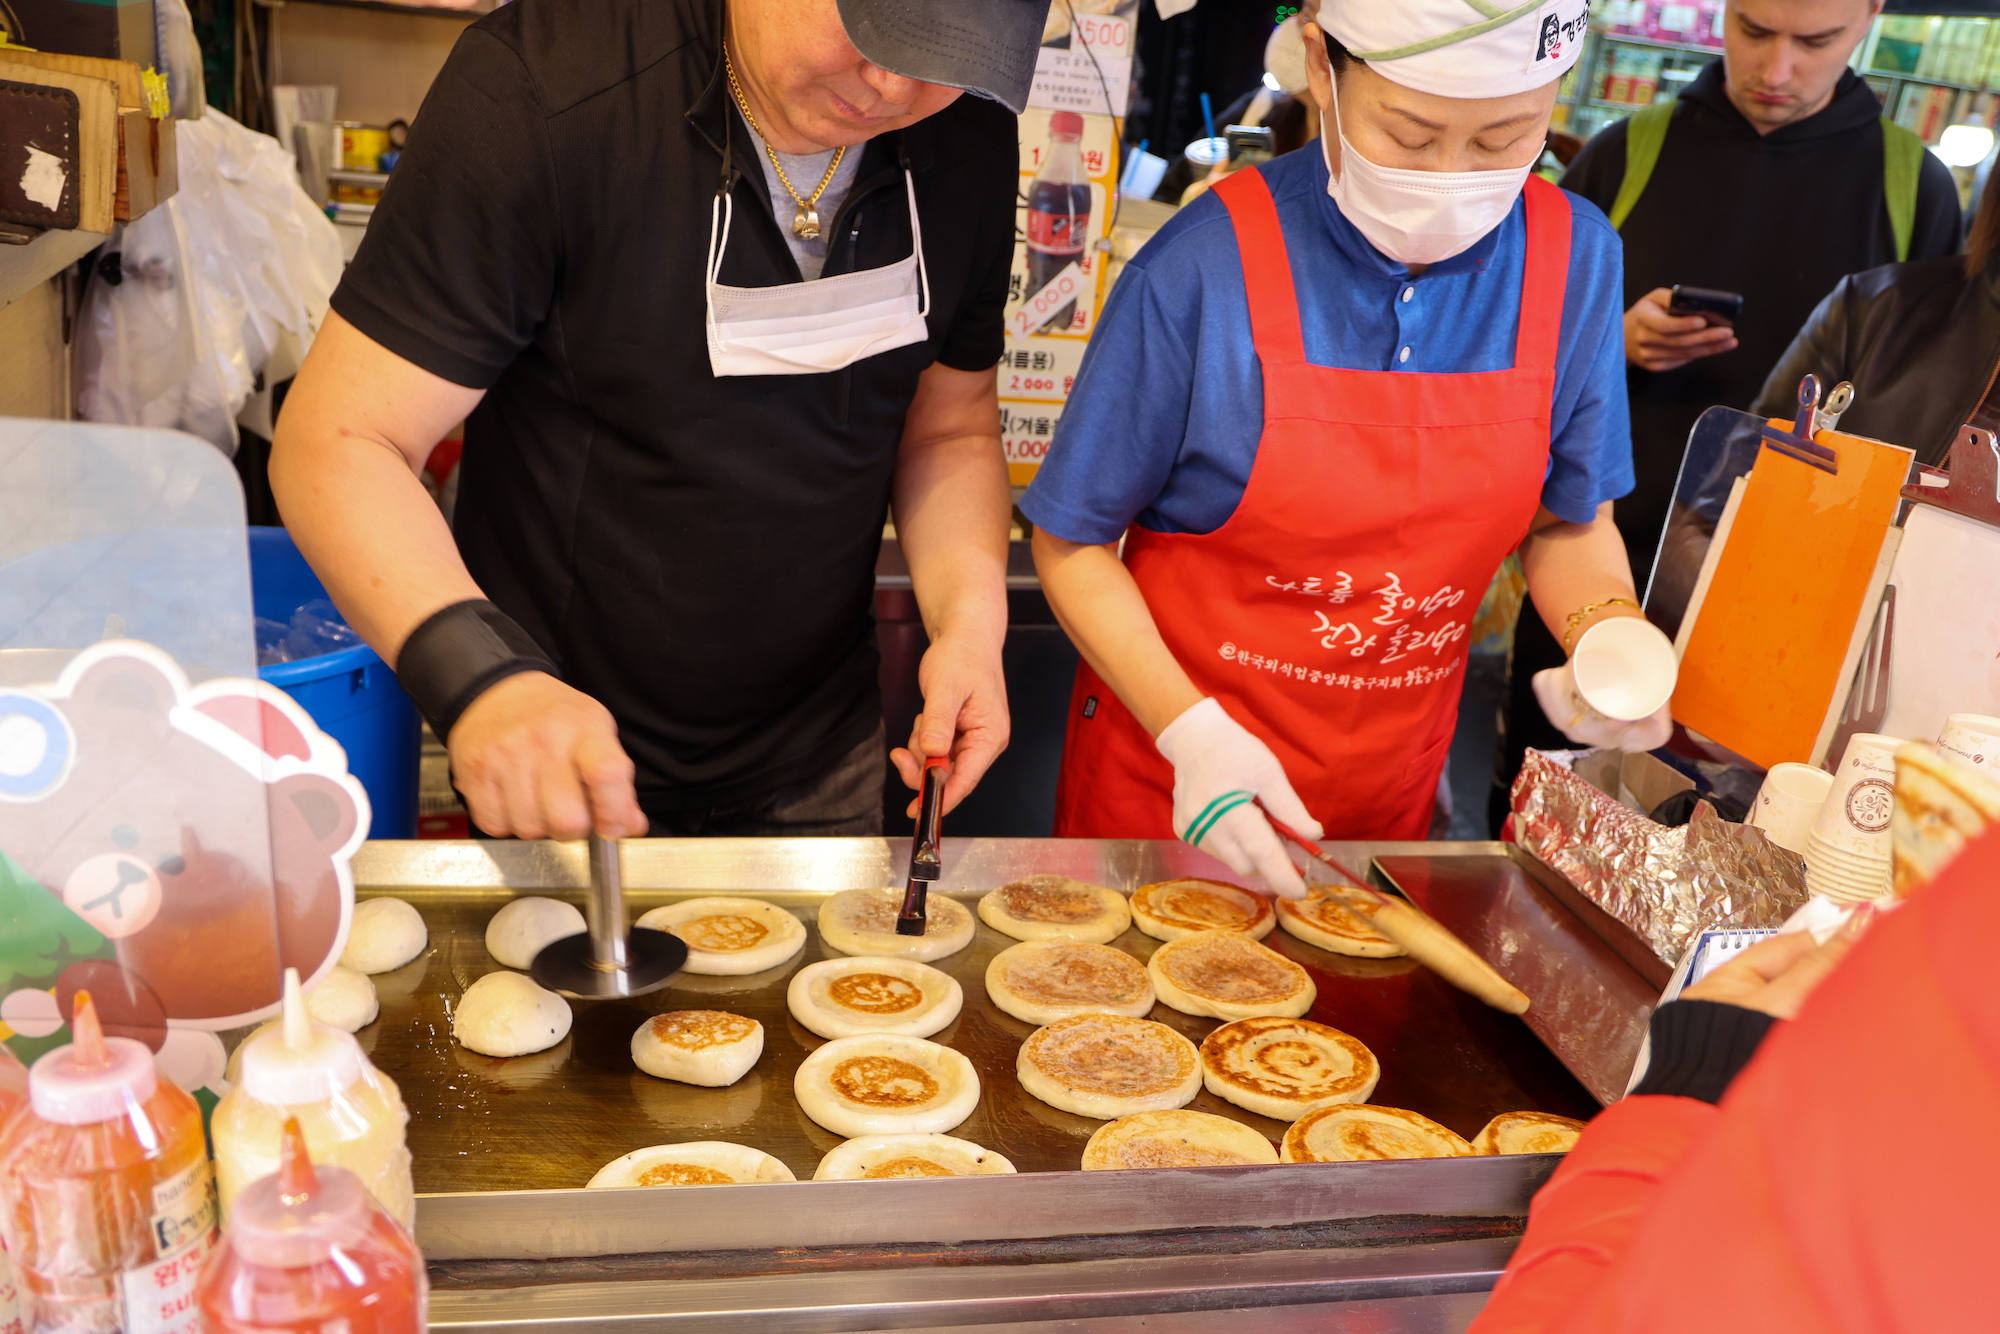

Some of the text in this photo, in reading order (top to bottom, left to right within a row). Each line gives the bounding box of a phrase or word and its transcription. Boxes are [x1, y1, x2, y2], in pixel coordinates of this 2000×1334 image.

[1076, 19, 1128, 48] 1500
[1265, 570, 1354, 604] 나트륨
[1310, 609, 1377, 657] 건강
